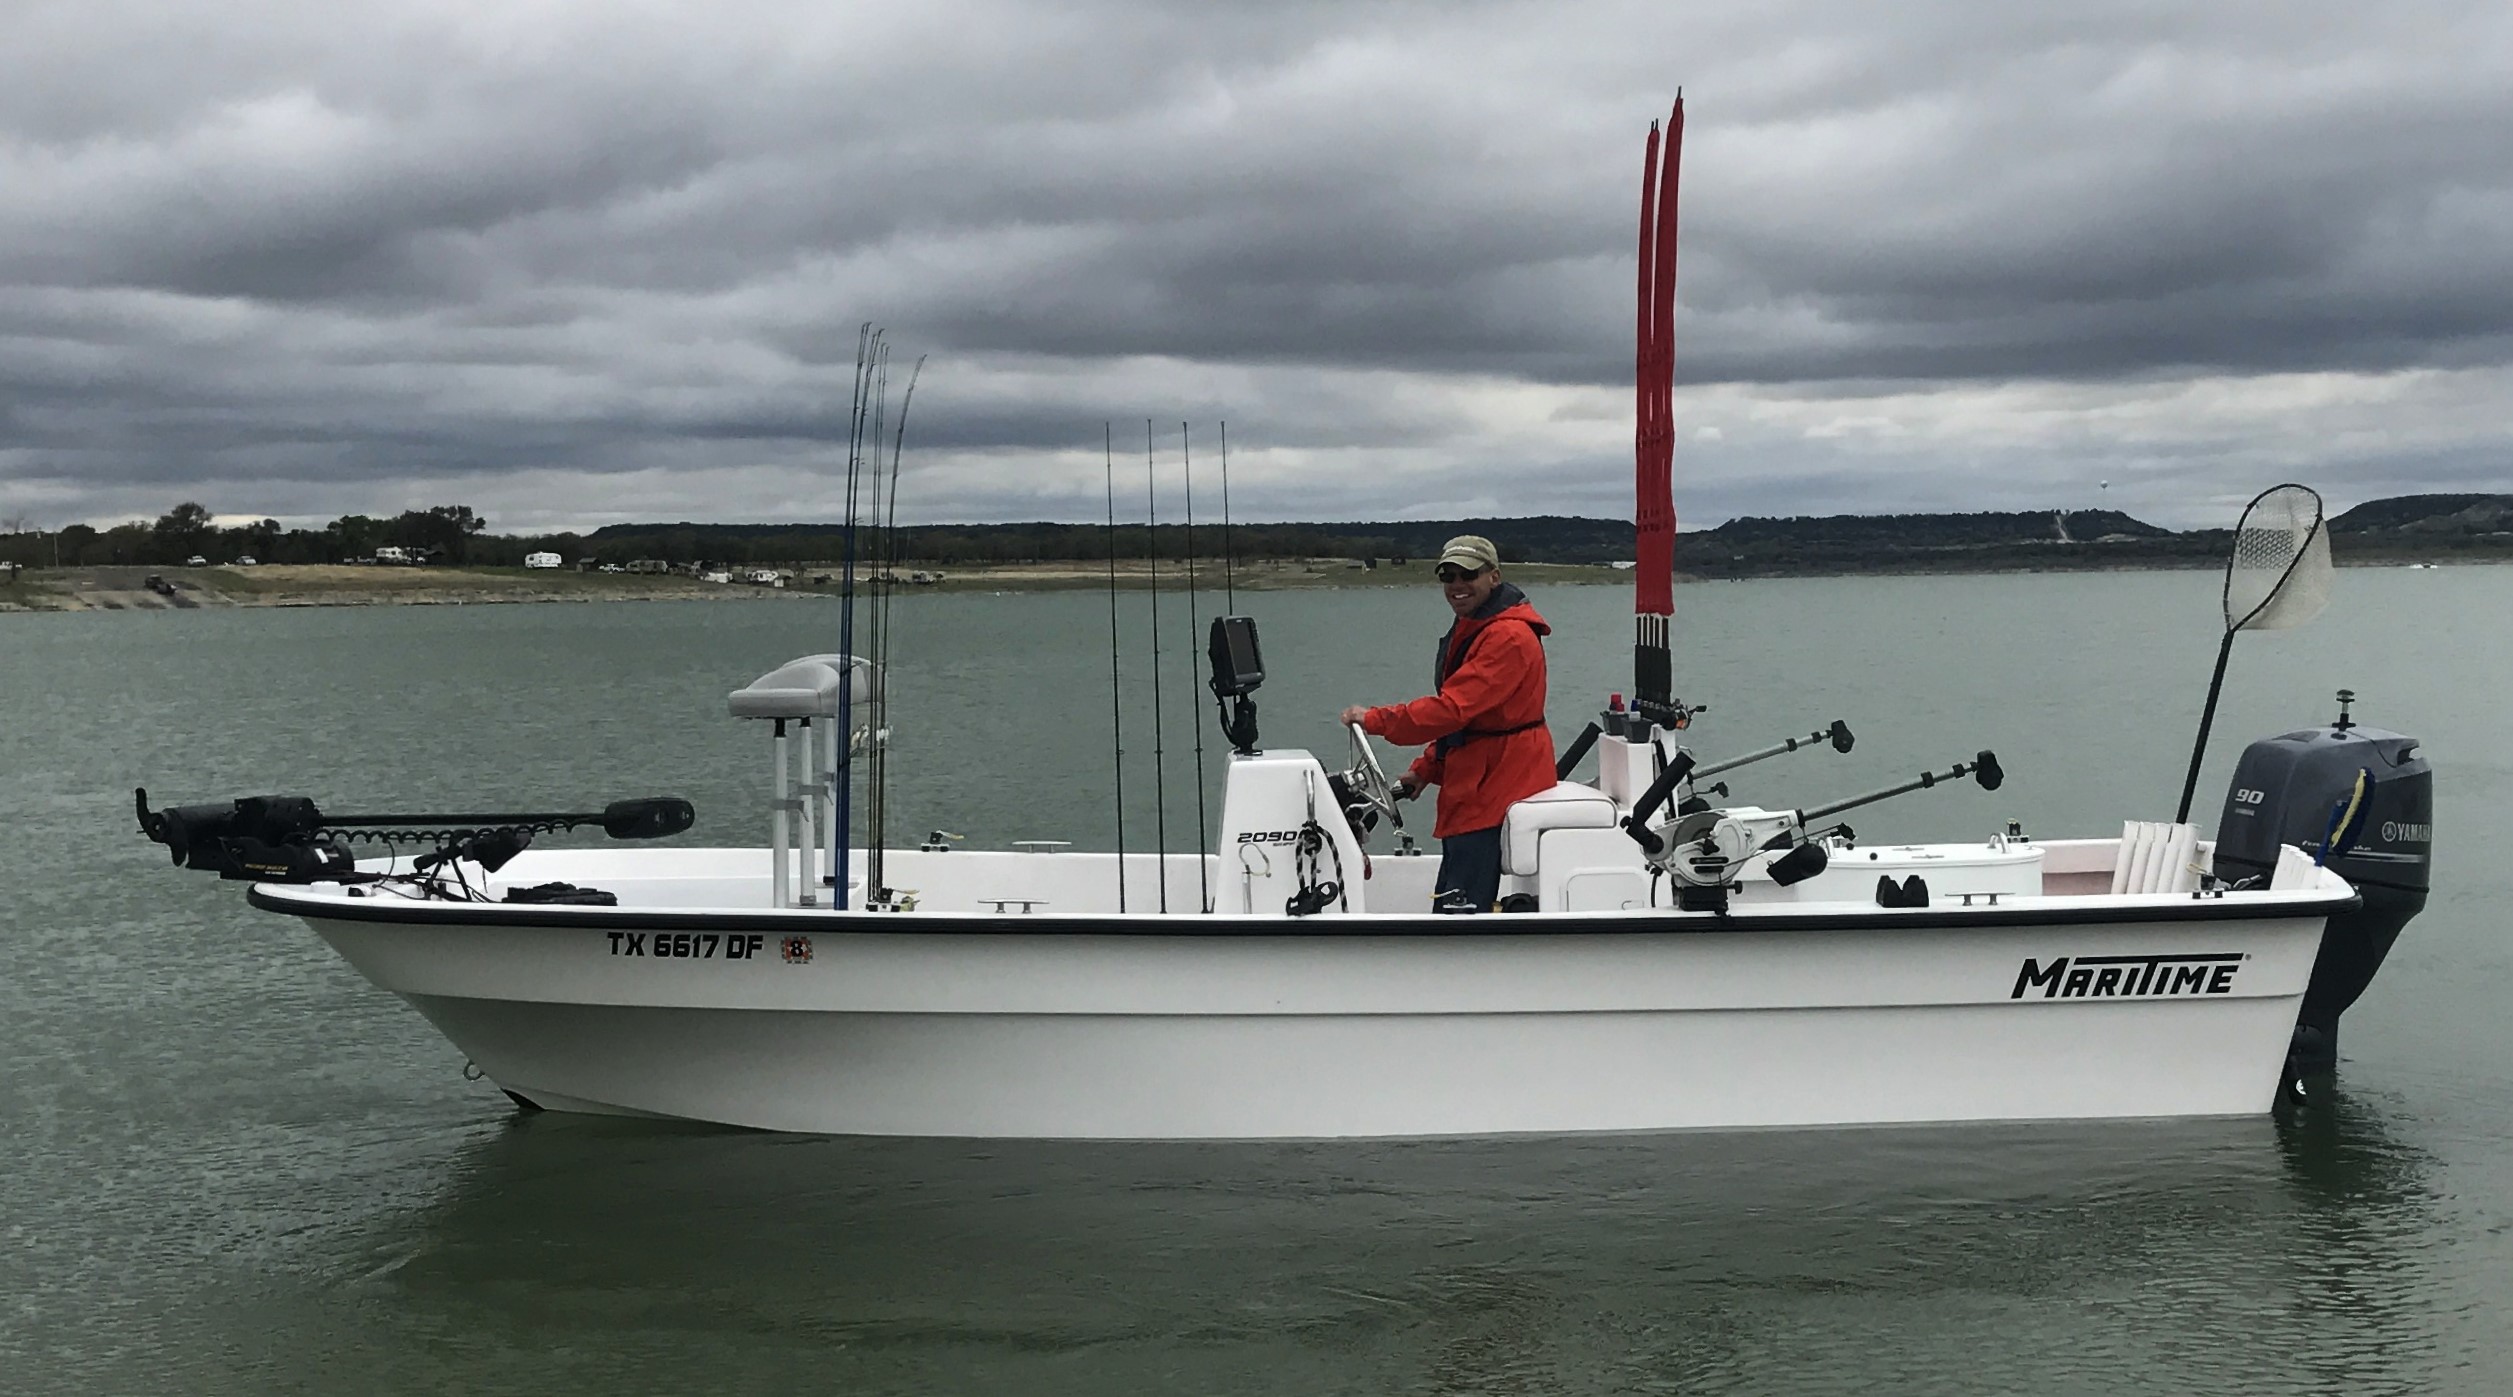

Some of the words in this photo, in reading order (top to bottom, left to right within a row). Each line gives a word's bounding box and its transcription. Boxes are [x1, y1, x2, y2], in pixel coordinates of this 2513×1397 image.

[2235, 788, 2265, 804] 90
[1237, 831, 1298, 843] 2090
[2397, 823, 2431, 842] YAMAH
[607, 932, 646, 956] TX
[653, 934, 720, 958] 6617
[726, 935, 763, 959] DF
[790, 940, 804, 957] 8
[2011, 952, 2244, 999] MARITIME
